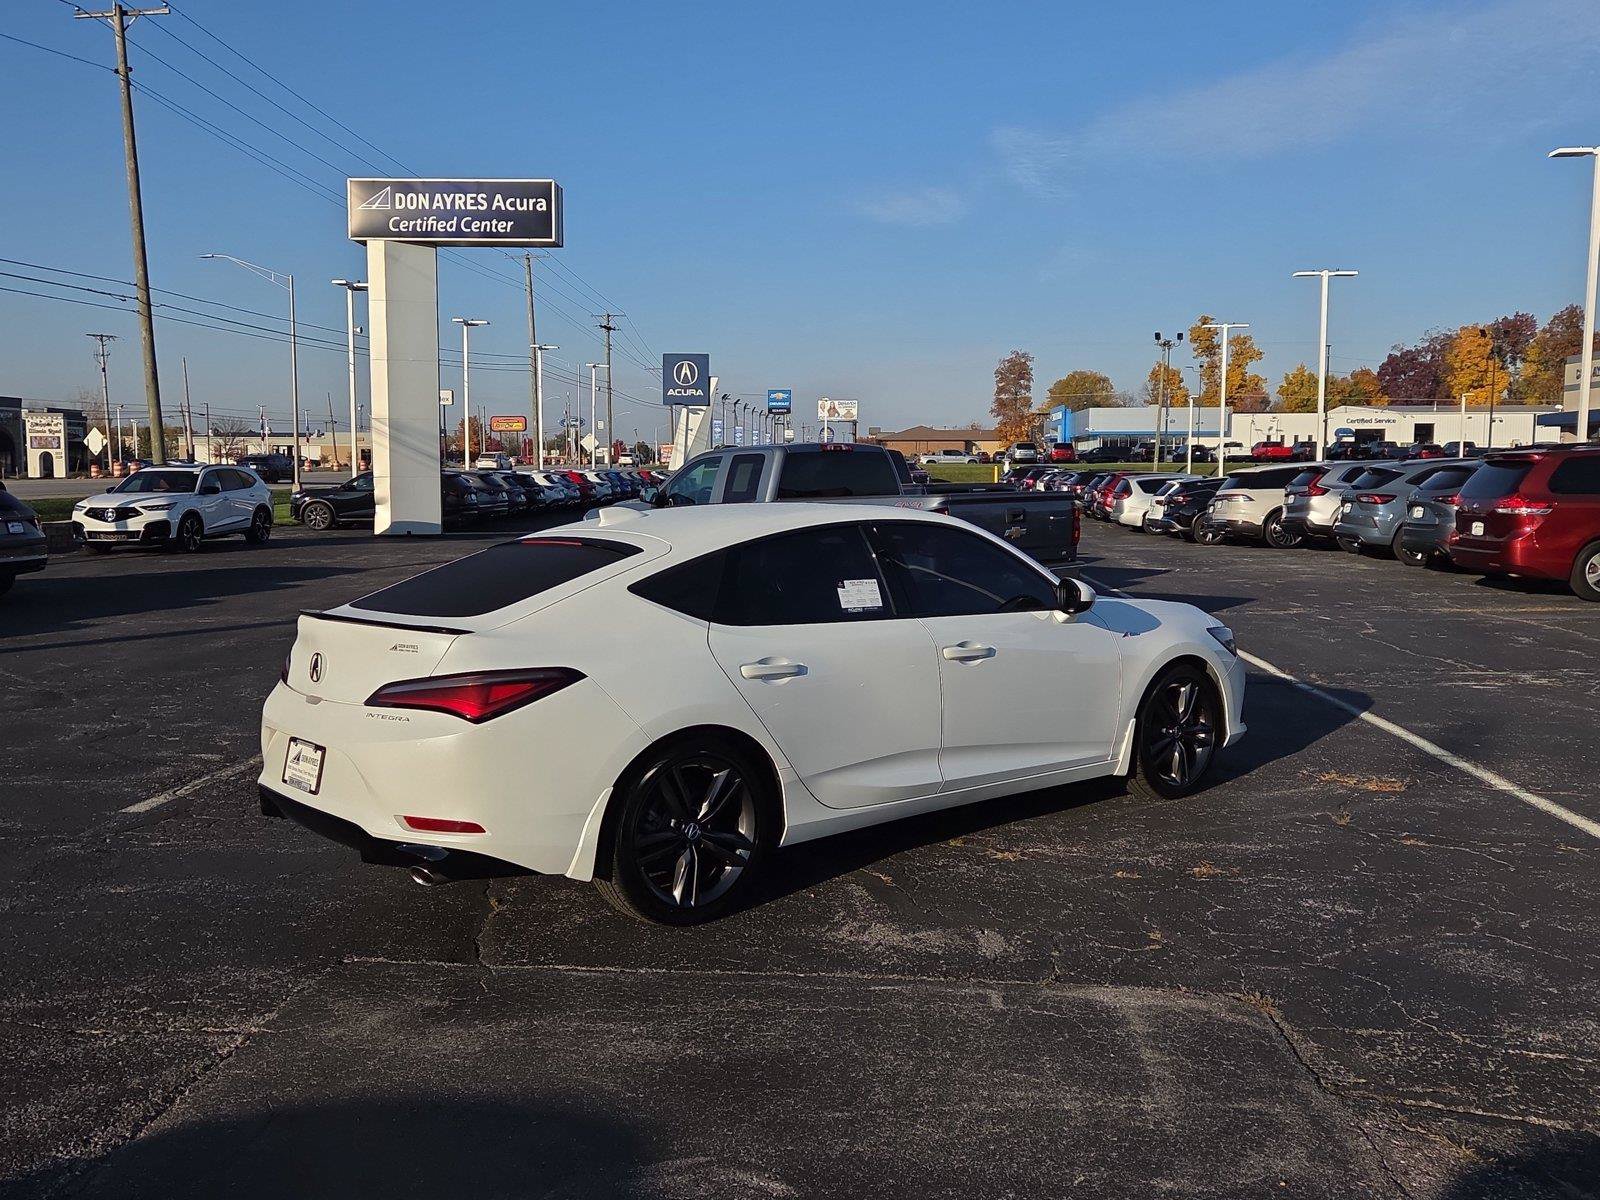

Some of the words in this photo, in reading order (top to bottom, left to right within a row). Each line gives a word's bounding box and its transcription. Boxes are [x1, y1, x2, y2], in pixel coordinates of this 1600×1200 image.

[395, 192, 430, 210] DON
[432, 193, 488, 211] AYRES
[491, 193, 547, 211] Acura
[388, 216, 457, 233] Certified
[460, 216, 514, 233] Center
[667, 388, 704, 396] ACURA
[365, 712, 410, 722] INTEGRA
